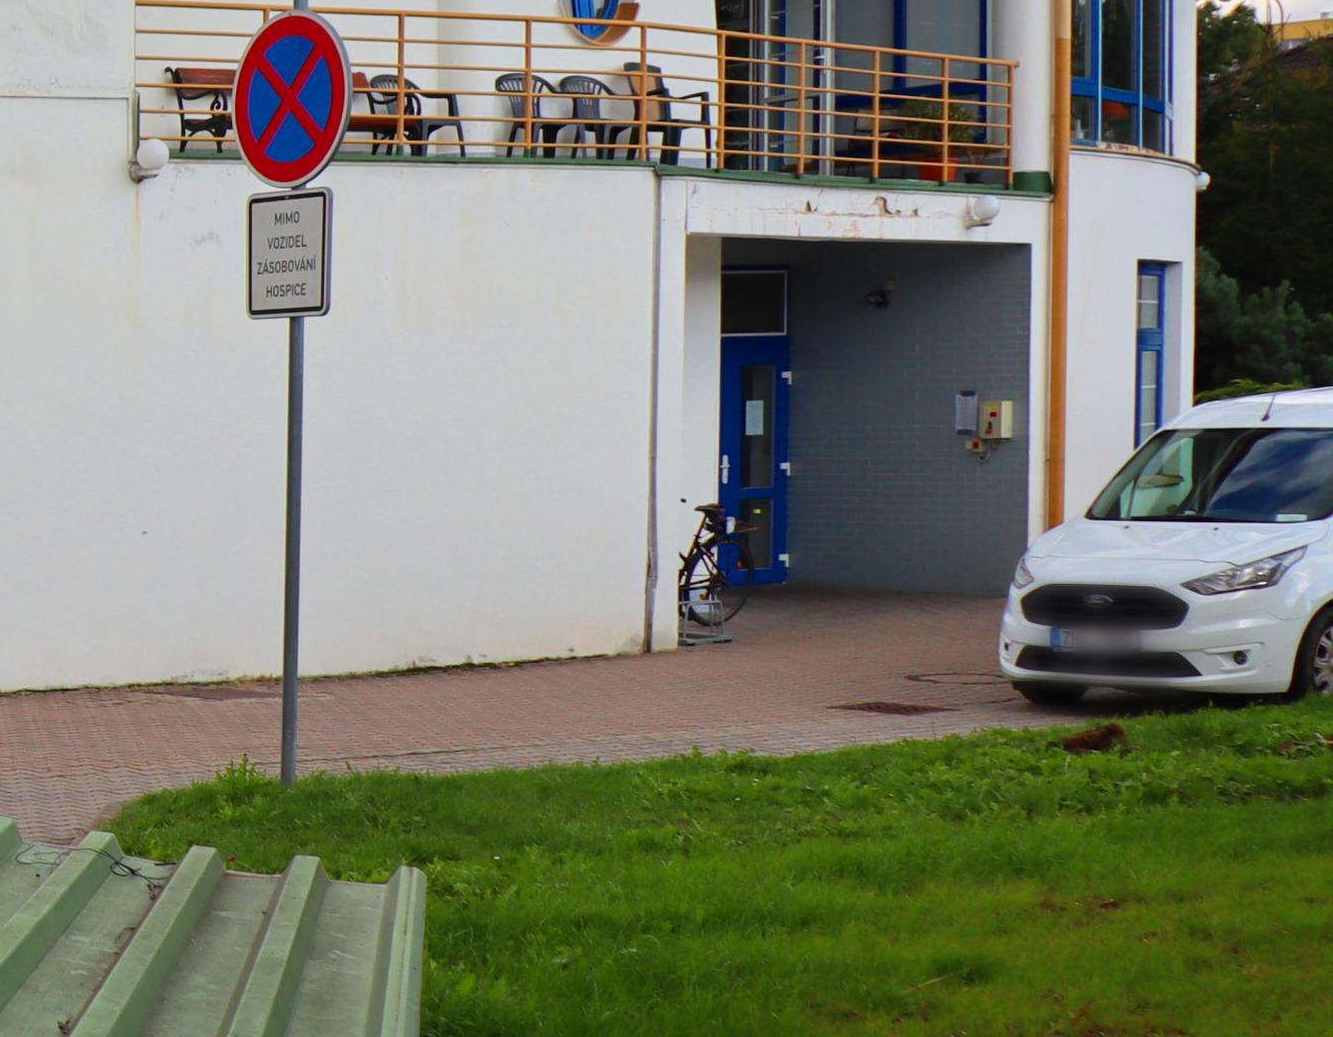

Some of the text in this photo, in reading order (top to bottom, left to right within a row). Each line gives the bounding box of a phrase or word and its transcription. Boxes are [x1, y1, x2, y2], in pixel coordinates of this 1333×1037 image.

[274, 211, 300, 226] MIMO
[267, 235, 307, 250] VOZIDEL
[256, 255, 317, 275] ZÁSOBOVÁNÍ
[266, 283, 307, 298] HOSPICE
